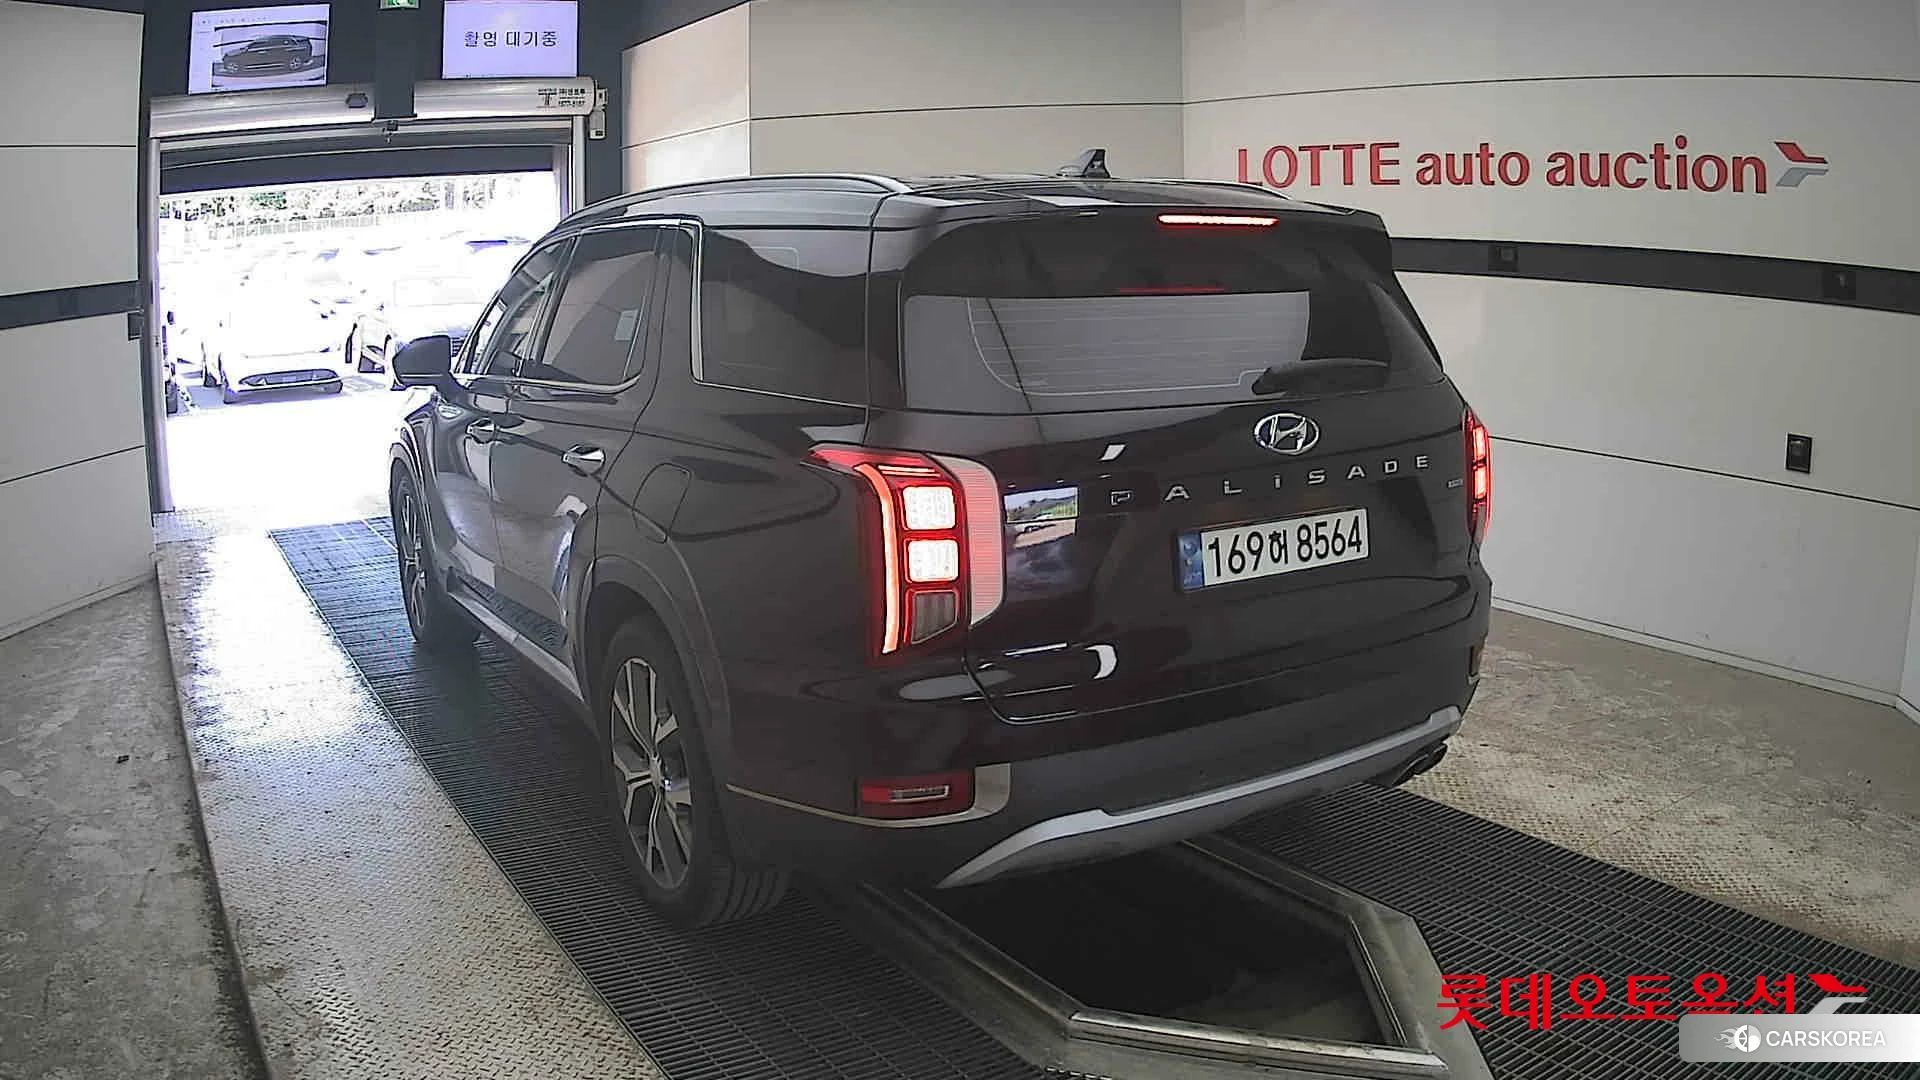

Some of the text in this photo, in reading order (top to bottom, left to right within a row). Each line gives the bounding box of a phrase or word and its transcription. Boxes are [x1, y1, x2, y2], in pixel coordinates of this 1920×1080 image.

[506, 31, 557, 47] 대기중
[1238, 135, 1768, 194] LOTTE auto auction
[1297, 516, 1362, 562] 8564
